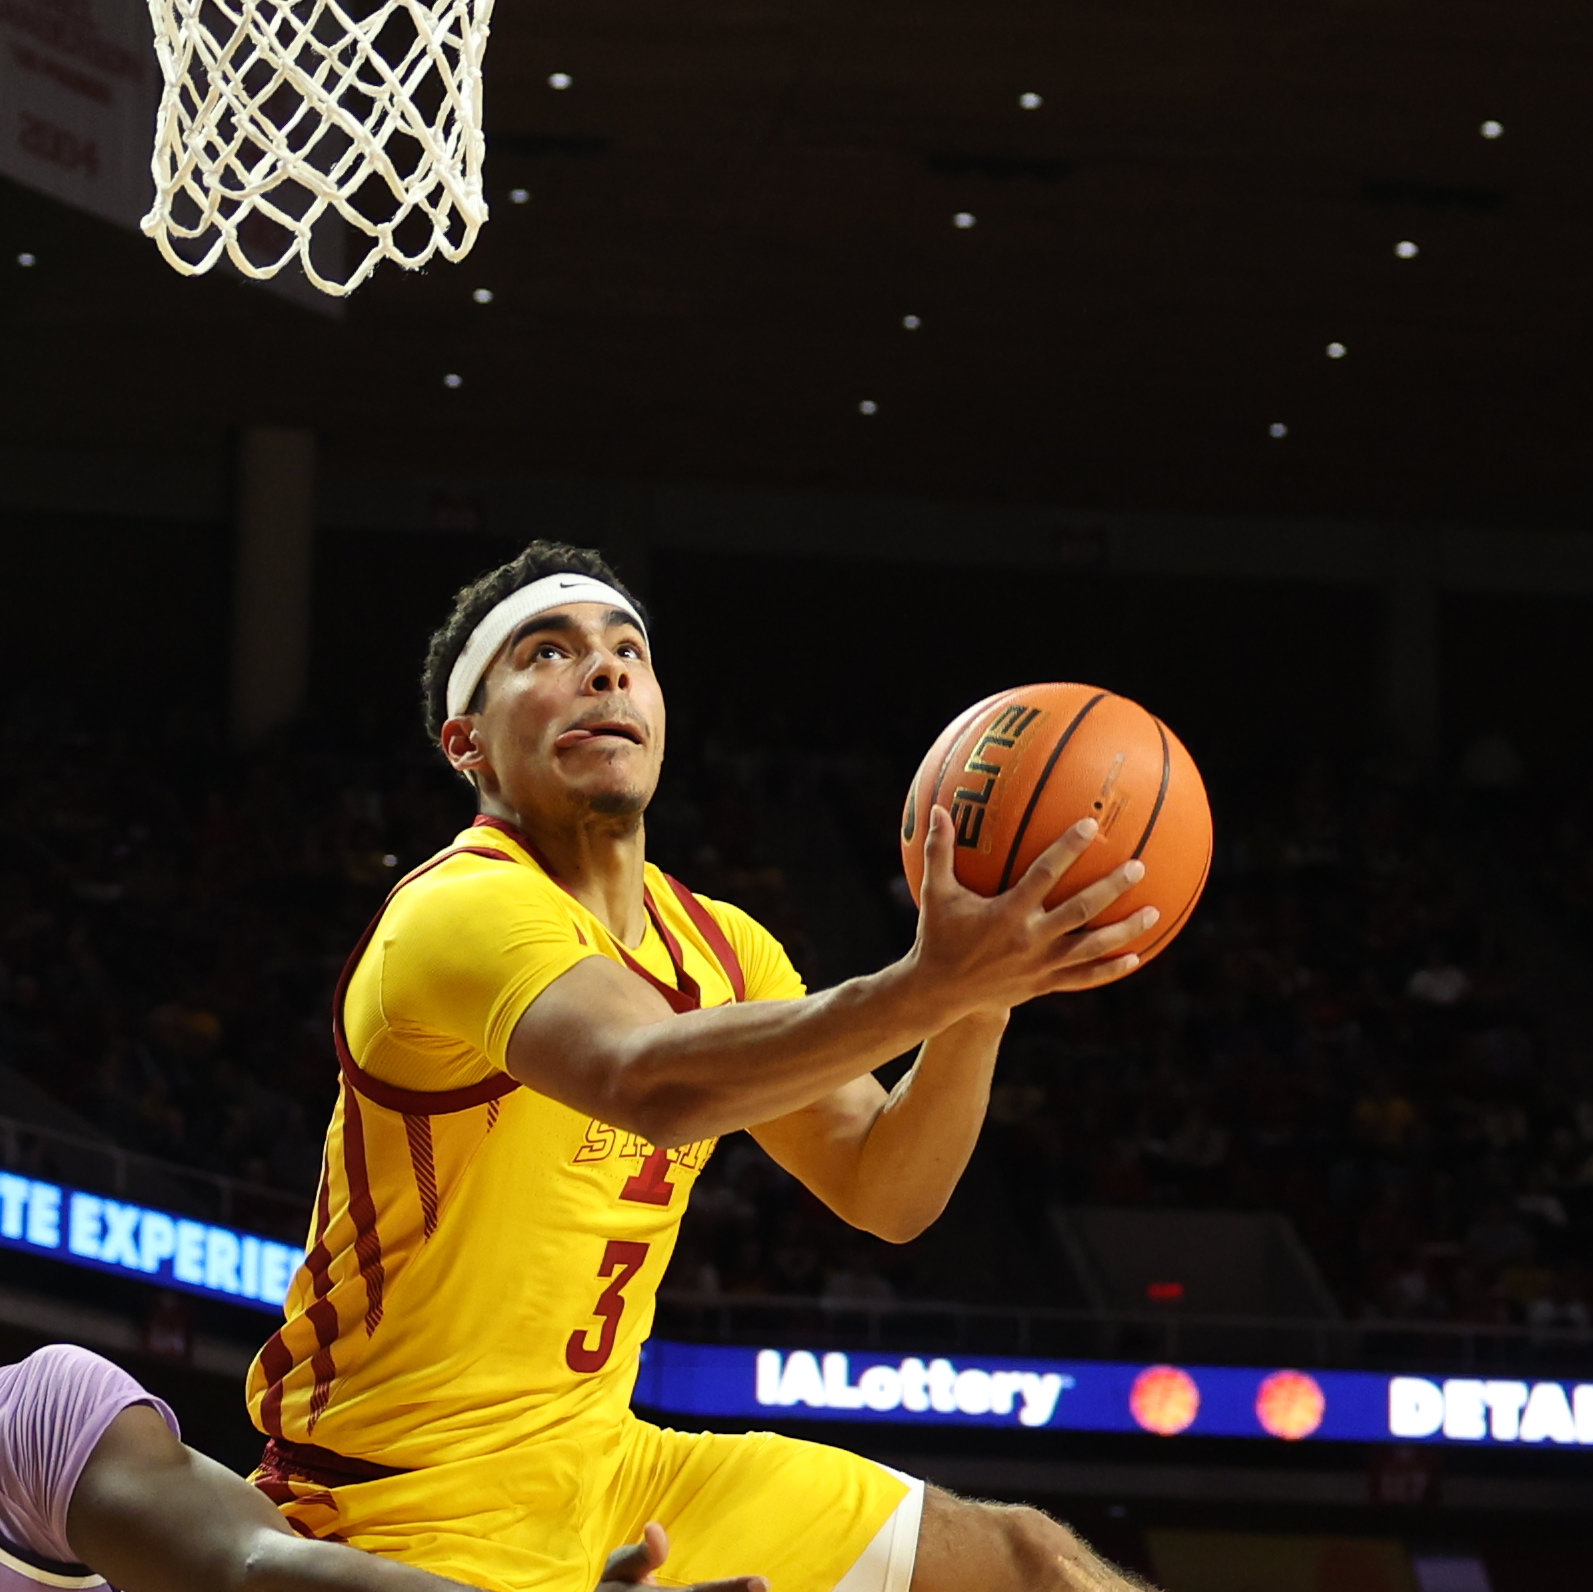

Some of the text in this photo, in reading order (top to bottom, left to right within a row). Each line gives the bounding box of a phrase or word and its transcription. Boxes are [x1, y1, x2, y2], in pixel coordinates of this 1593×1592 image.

[951, 704, 1041, 849] ELITE
[566, 1240, 649, 1374] 3
[756, 1349, 1062, 1427] IALottery
